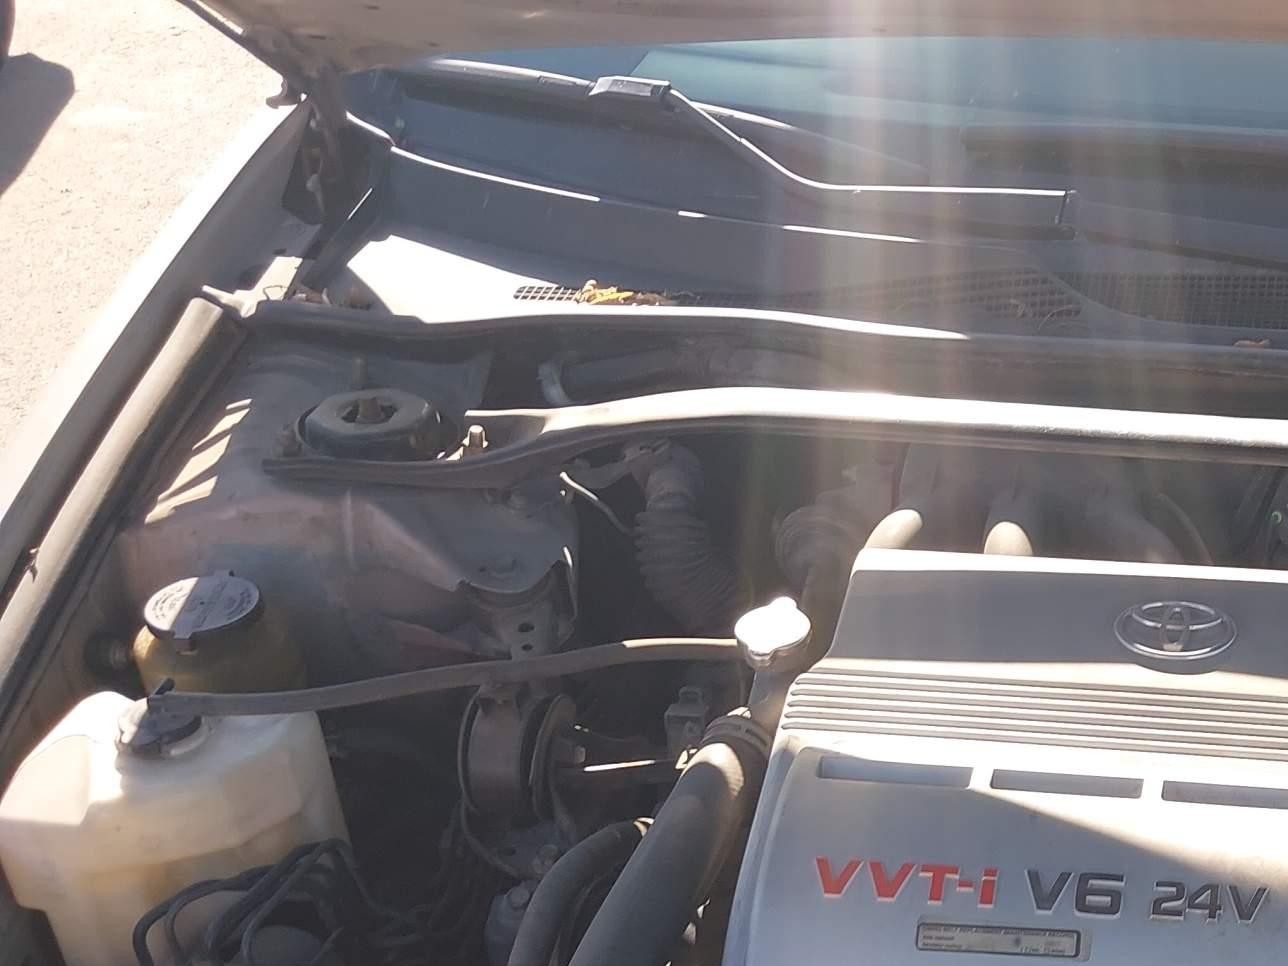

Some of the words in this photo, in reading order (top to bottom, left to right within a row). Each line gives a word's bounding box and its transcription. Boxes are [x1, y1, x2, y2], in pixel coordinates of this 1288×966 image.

[816, 856, 999, 908] VVT-i
[1025, 869, 1126, 919] V6
[1150, 881, 1270, 924] 24V
